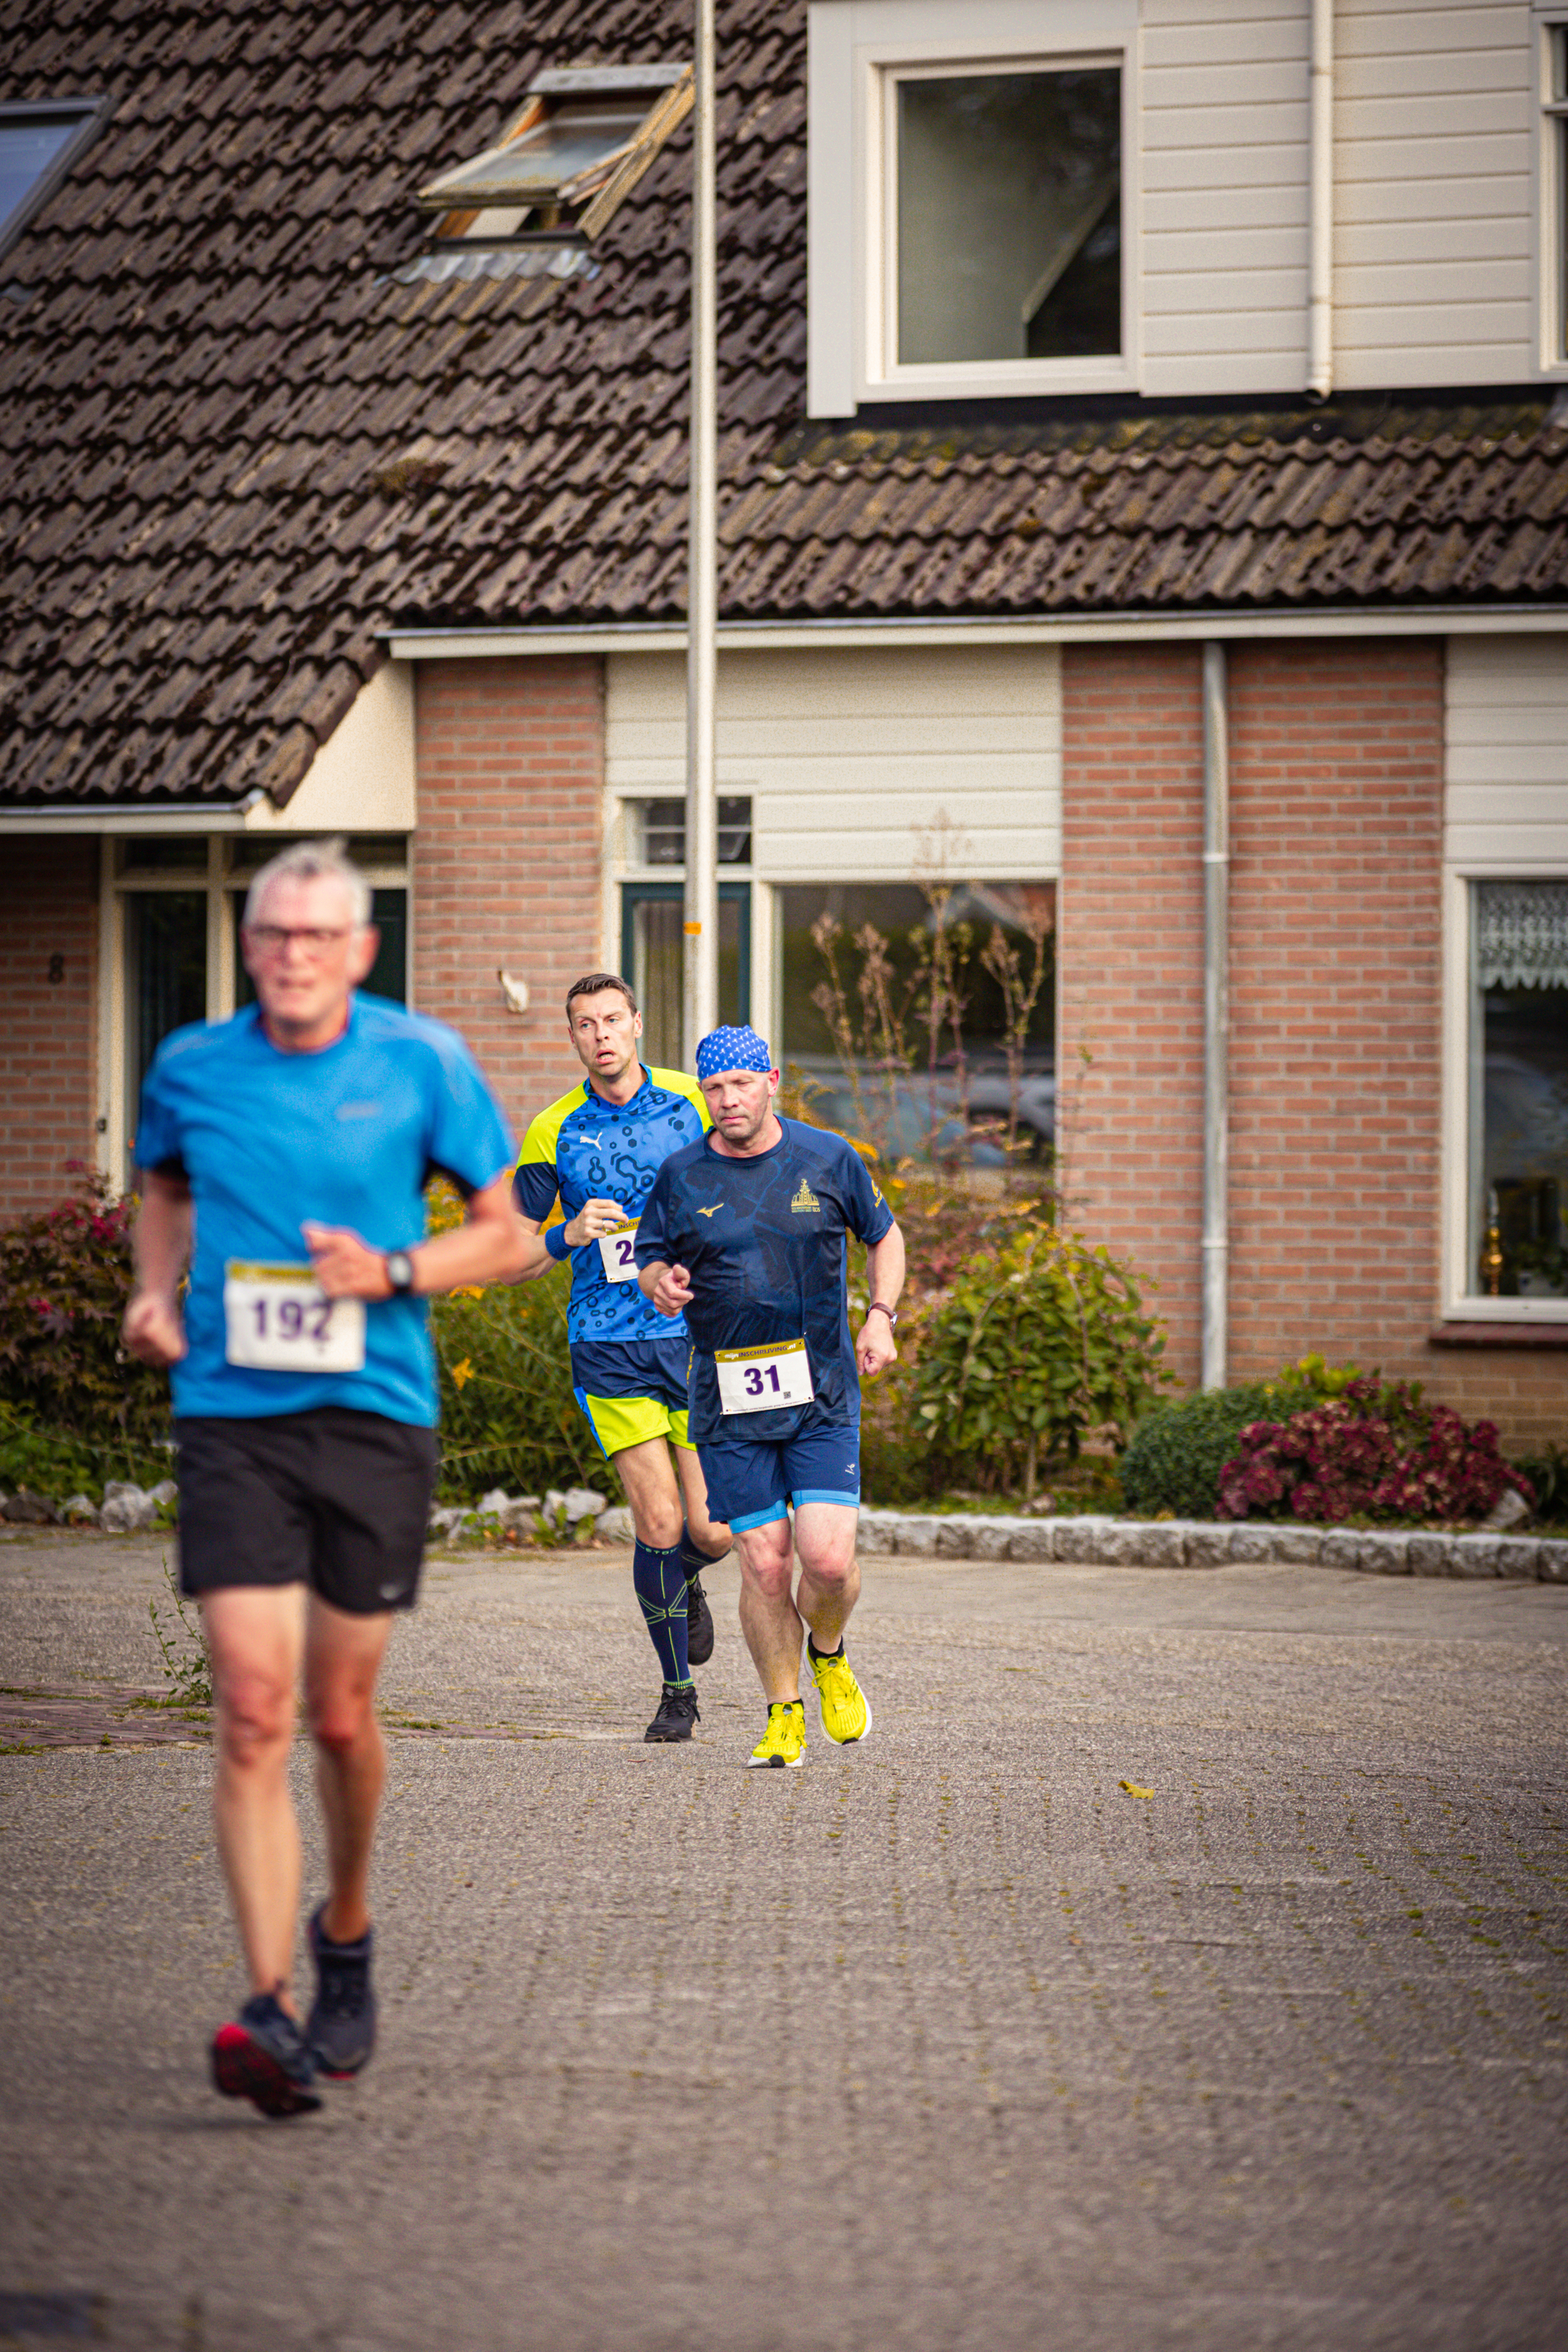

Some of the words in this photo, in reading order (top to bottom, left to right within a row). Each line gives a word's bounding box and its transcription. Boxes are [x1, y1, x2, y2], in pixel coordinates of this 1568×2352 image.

[49, 953, 64, 984] 8
[251, 1298, 334, 1342] 192
[743, 1364, 780, 1396] 31
